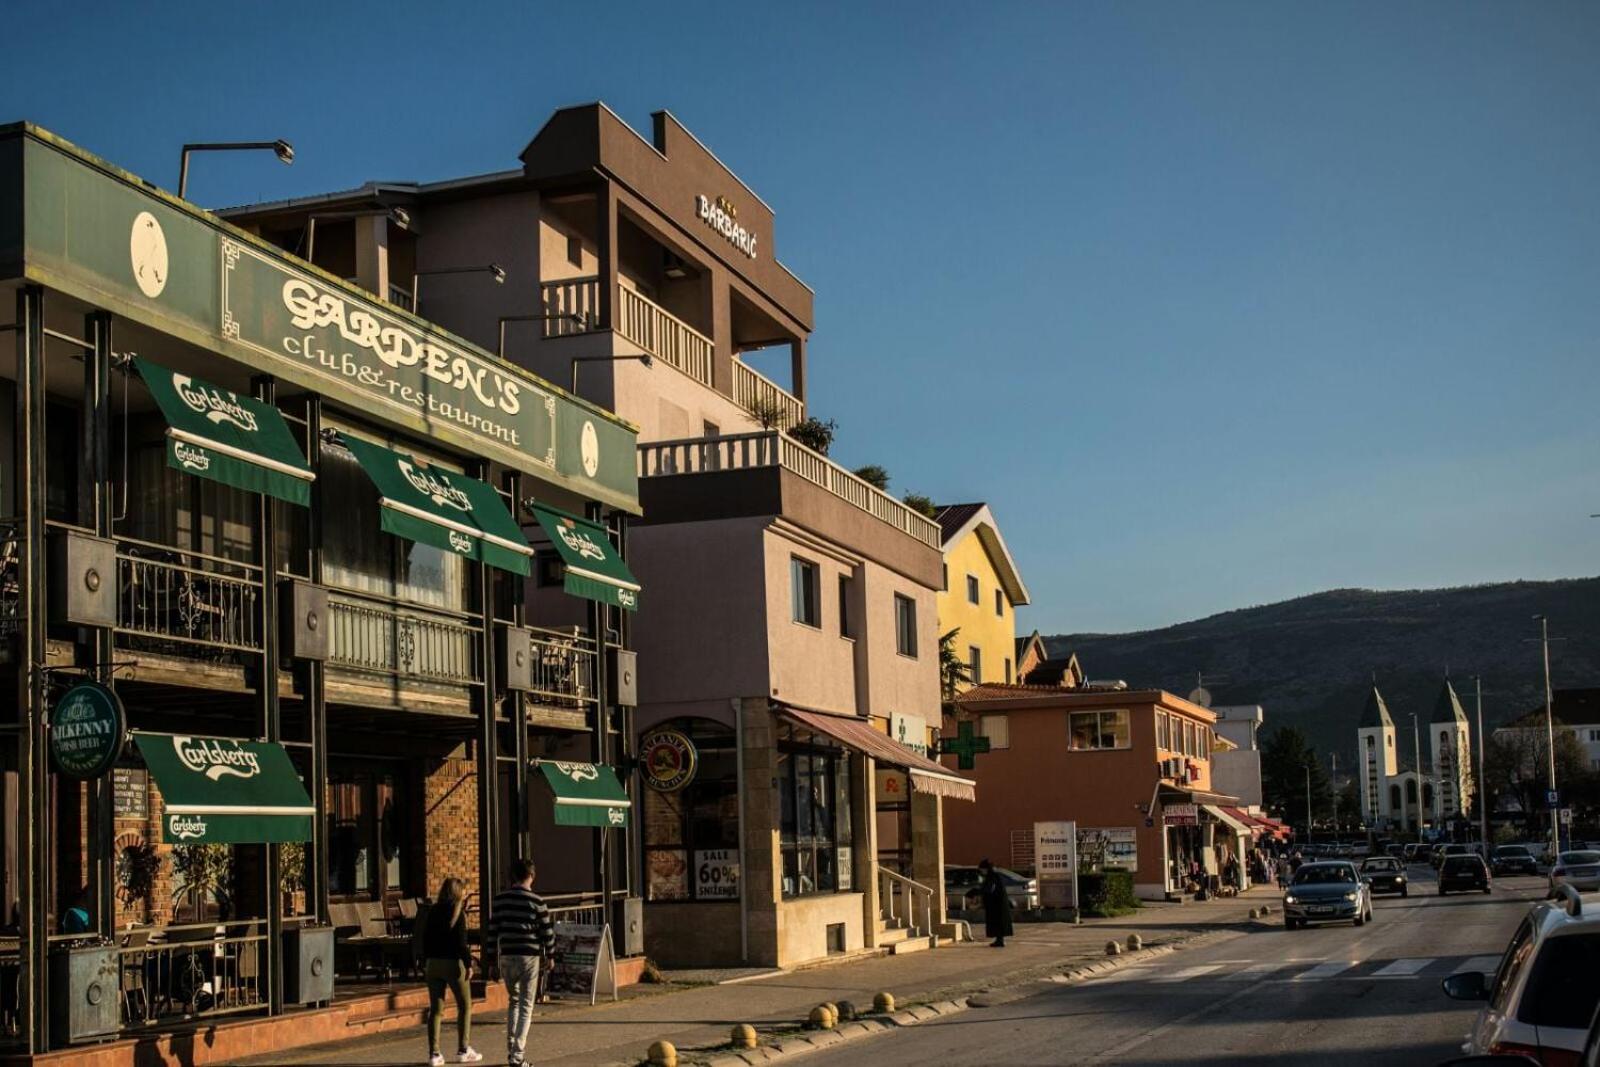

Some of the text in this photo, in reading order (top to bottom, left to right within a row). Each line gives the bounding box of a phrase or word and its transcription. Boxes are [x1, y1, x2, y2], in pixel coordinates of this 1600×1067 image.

[282, 279, 520, 416] GARDEN'S
[173, 372, 259, 432] Carlsberg
[174, 441, 210, 470] Carlsberg
[398, 459, 473, 512] Carlsberg
[173, 736, 260, 781] Carlsberg
[169, 815, 207, 840] Carlsberg
[699, 862, 737, 884] 60%
[703, 850, 728, 860] SALE
